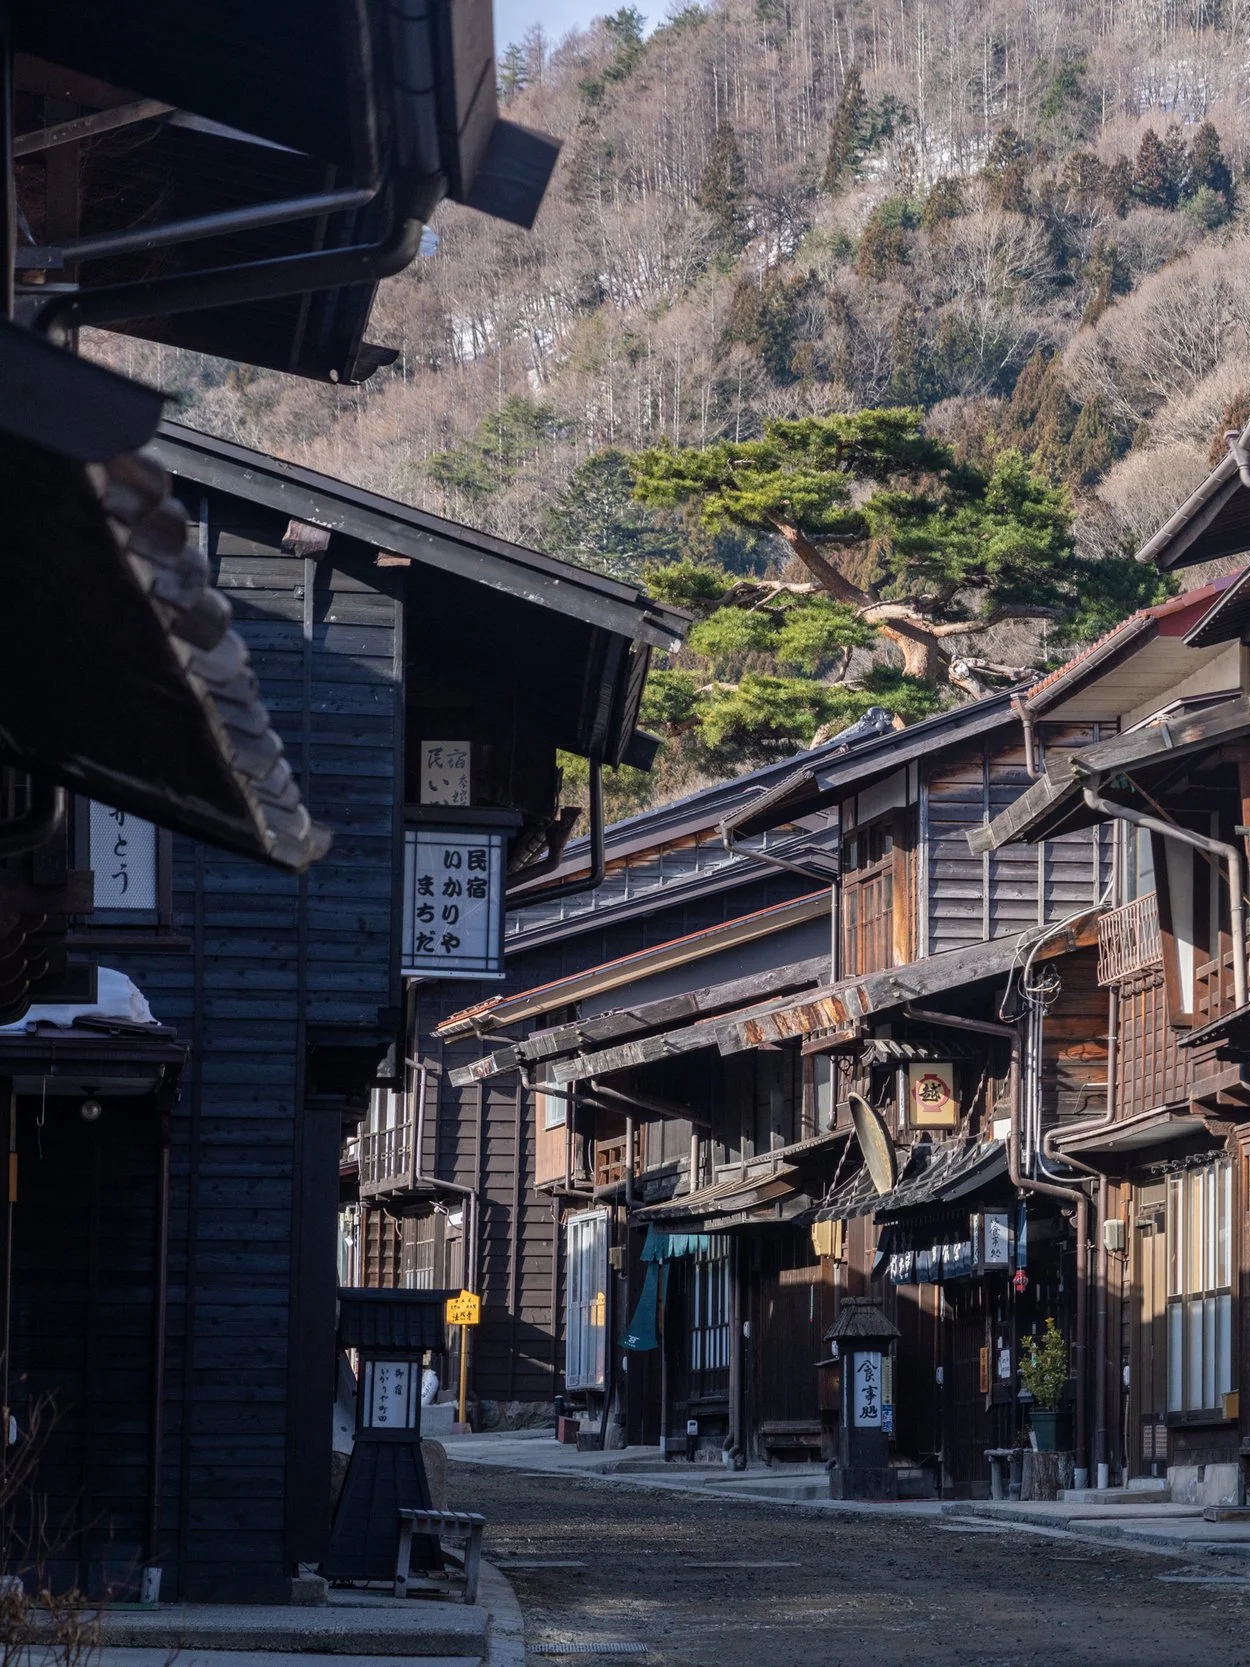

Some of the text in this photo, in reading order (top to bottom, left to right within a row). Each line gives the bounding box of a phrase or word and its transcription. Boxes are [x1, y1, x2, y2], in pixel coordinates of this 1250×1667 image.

[441, 849, 463, 954] いかりや
[466, 849, 488, 899] 民宿
[416, 874, 436, 954] まちだ
[856, 1359, 879, 1419] 食事処
